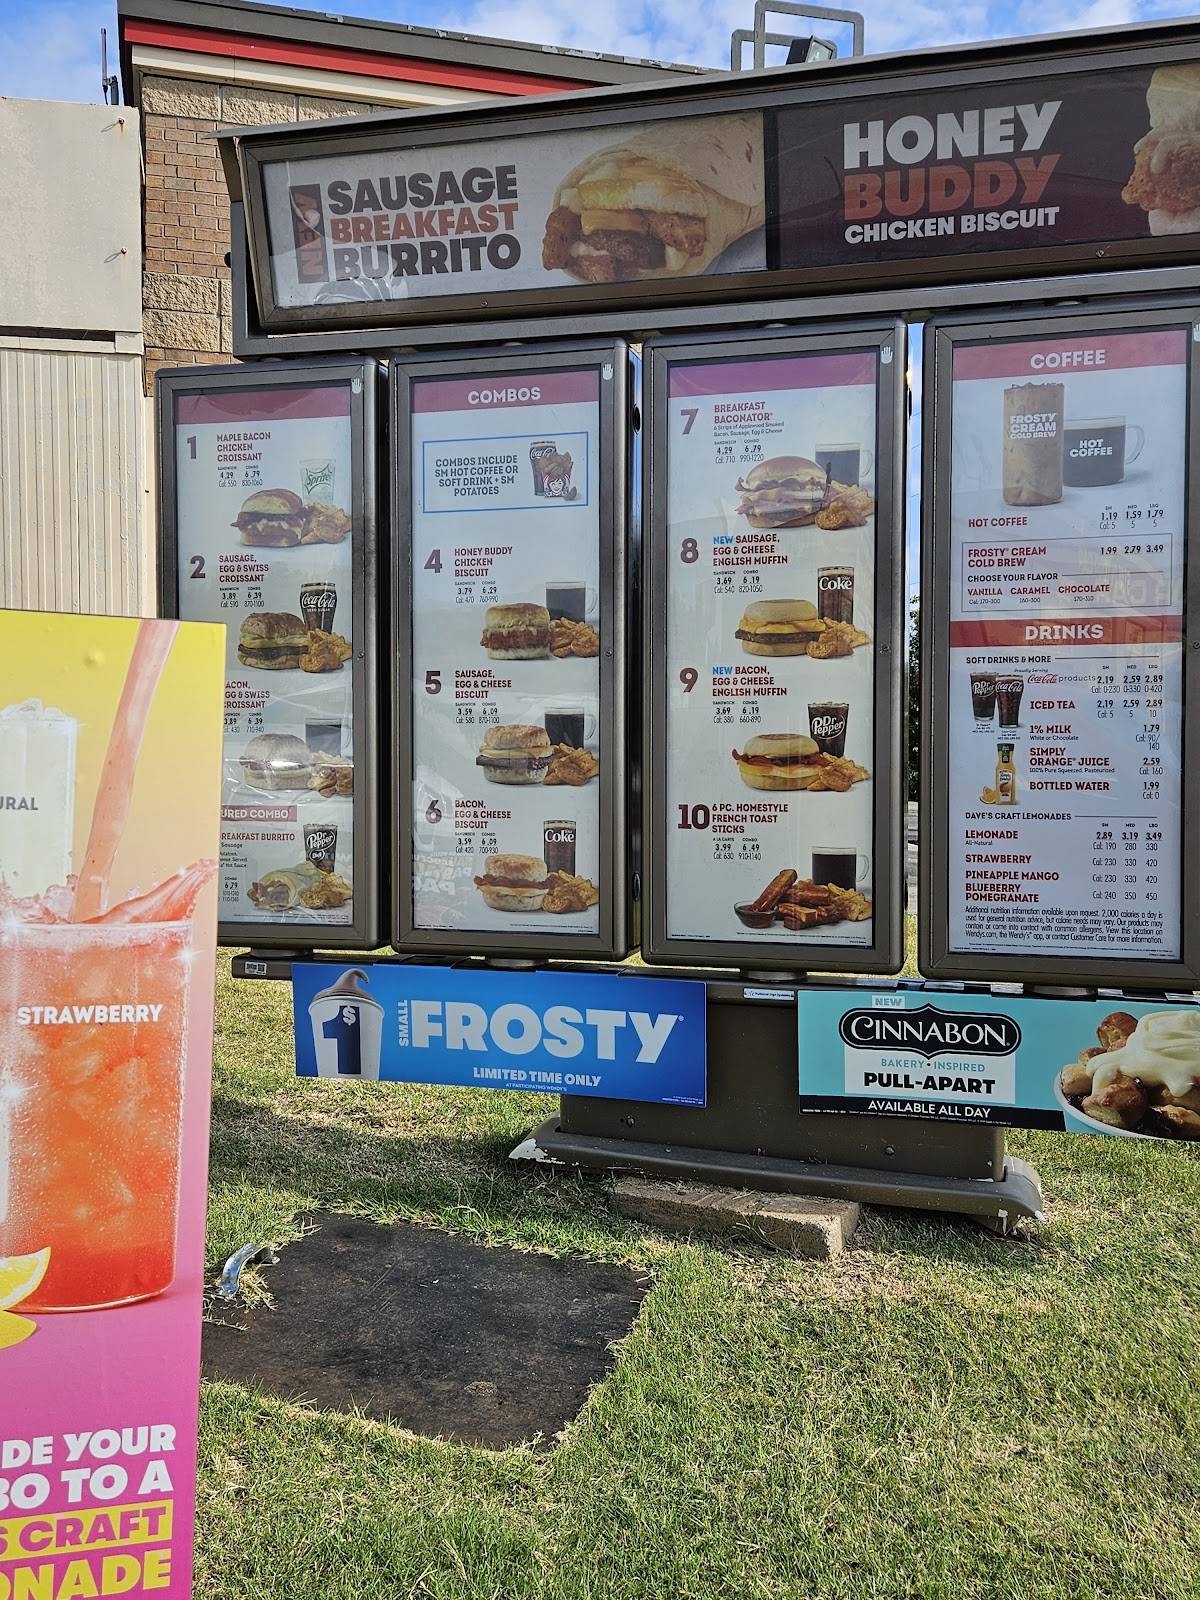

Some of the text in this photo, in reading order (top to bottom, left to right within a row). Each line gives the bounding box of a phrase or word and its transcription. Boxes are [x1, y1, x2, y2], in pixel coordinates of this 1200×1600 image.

[843, 100, 1062, 169] HONEY
[328, 164, 519, 215] SAUSAGE
[844, 155, 1061, 220] BUDDY
[331, 202, 520, 246] BREAKFAST
[844, 207, 1060, 244] CHICKEN BISCUIT
[333, 233, 522, 280] BURRITO
[1030, 349, 1106, 370] COFFEE
[468, 387, 541, 404] COMBOS
[714, 402, 766, 413] BREAKFAST
[681, 408, 699, 435] 7
[714, 413, 771, 424] BACONATOR
[1010, 413, 1056, 424] FROSTY
[1010, 422, 1057, 432] CREAM
[217, 432, 271, 443] MAPLE BACON
[1010, 429, 1057, 439] COLD BREW
[187, 435, 197, 460] 1
[217, 443, 253, 452] CHICKEN
[1080, 439, 1103, 449] HOT
[1070, 446, 1113, 458] COFFEE
[217, 453, 262, 462] CROISSANT
[435, 455, 518, 467] COMBOS INCLUDE
[435, 465, 519, 478] SM HOT COFFEE OR
[439, 475, 515, 487] SOFT DRINK SM
[454, 486, 500, 496] POTATOES
[969, 516, 1028, 528] HOT COFFEE
[713, 534, 781, 545] NEW SAUSAGE,
[454, 547, 513, 557] HONEY BUDDY
[680, 537, 699, 563] 8
[713, 545, 775, 555] EGG CHEESE
[1011, 546, 1047, 556] CREAM
[1101, 545, 1164, 555] 1.99 2.79 3.49
[219, 555, 257, 564] SAUSAGE,
[424, 549, 443, 573] 4
[454, 557, 493, 567] CHICKEN
[713, 556, 788, 566] ENGLISH MUFFIN
[968, 557, 1027, 568] COLD BREW
[190, 555, 206, 579] 2
[219, 563, 269, 573] EGG SWISS
[454, 568, 489, 577] BISCUIT
[967, 572, 1059, 583] CHOOSE YOUR FLAVOR
[219, 574, 264, 583] CROISSANT
[819, 576, 853, 590] Coke
[967, 584, 1111, 596] VANILLA CARAMEL CHOCOLATE
[1024, 624, 1105, 641] DRINKS
[966, 655, 1052, 664] SOFT DRINKS MORE
[455, 669, 496, 679] SAUSAGE,
[712, 665, 770, 675] NEW BACON,
[425, 670, 442, 695] 5
[455, 679, 512, 689] EGG CHEESE
[680, 667, 699, 693] 9
[712, 676, 775, 685] EGG CHEESE
[1058, 675, 1096, 683] products
[225, 681, 250, 689] ACON,
[225, 690, 270, 699] GG SWISS
[455, 690, 489, 699] BISCUIT
[712, 687, 788, 697] ENGLISH MUFFIN
[1030, 700, 1076, 710] ICED TEA
[1097, 699, 1163, 708] 2.19 2.59 2.89
[1046, 725, 1072, 734] MILK
[1143, 724, 1160, 733] 1.79
[1030, 748, 1065, 758] SIMPLY
[1079, 758, 1110, 767] JUICE
[1143, 757, 1161, 766] 2.59
[1030, 781, 1110, 791] BOTTLED WATER
[1144, 781, 1160, 790] 1.99
[455, 799, 487, 809] BACON,
[737, 803, 789, 812] HOMESTYLE
[249, 809, 289, 819] COMBO
[425, 799, 442, 824] 6
[455, 809, 512, 819] EGG CHEESE
[678, 803, 711, 829] 10
[712, 813, 778, 823] FRENCH TOAST
[965, 812, 1071, 822] DAVE'S CRAFT LEMONADES
[455, 820, 489, 829] BISCUIT
[712, 824, 745, 833] STICKS
[221, 833, 296, 841] REAKFAST BURRITO
[544, 829, 575, 843] Coke
[965, 830, 1019, 840] LEMONADE
[1096, 832, 1162, 841] 2.89 3.19 3.49
[965, 854, 1032, 865] STRAWBERRY
[965, 871, 1059, 882] PINEAPPLE MANGO
[965, 883, 1021, 893] BLUEBERRY
[965, 893, 1039, 904] POMEGRANATE
[874, 997, 902, 1006] NEW
[16, 1005, 163, 1025] STRAWBERRY
[398, 999, 409, 1048] SMALL
[411, 999, 679, 1064] FROSTY
[851, 1015, 1006, 1047] CINNABON
[881, 1058, 985, 1072] BAKERY INSPIRED
[473, 1067, 602, 1087] LIMITED TIME ONLY
[864, 1072, 996, 1094] PULL-APART
[868, 1099, 936, 1114] AVAILABLE
[938, 1104, 962, 1117] ALL
[964, 1107, 991, 1118] DAY
[63, 1424, 177, 1461] YOUR
[61, 1464, 128, 1503] TO
[137, 1459, 174, 1495] A
[19, 1506, 167, 1552] CRAFT
